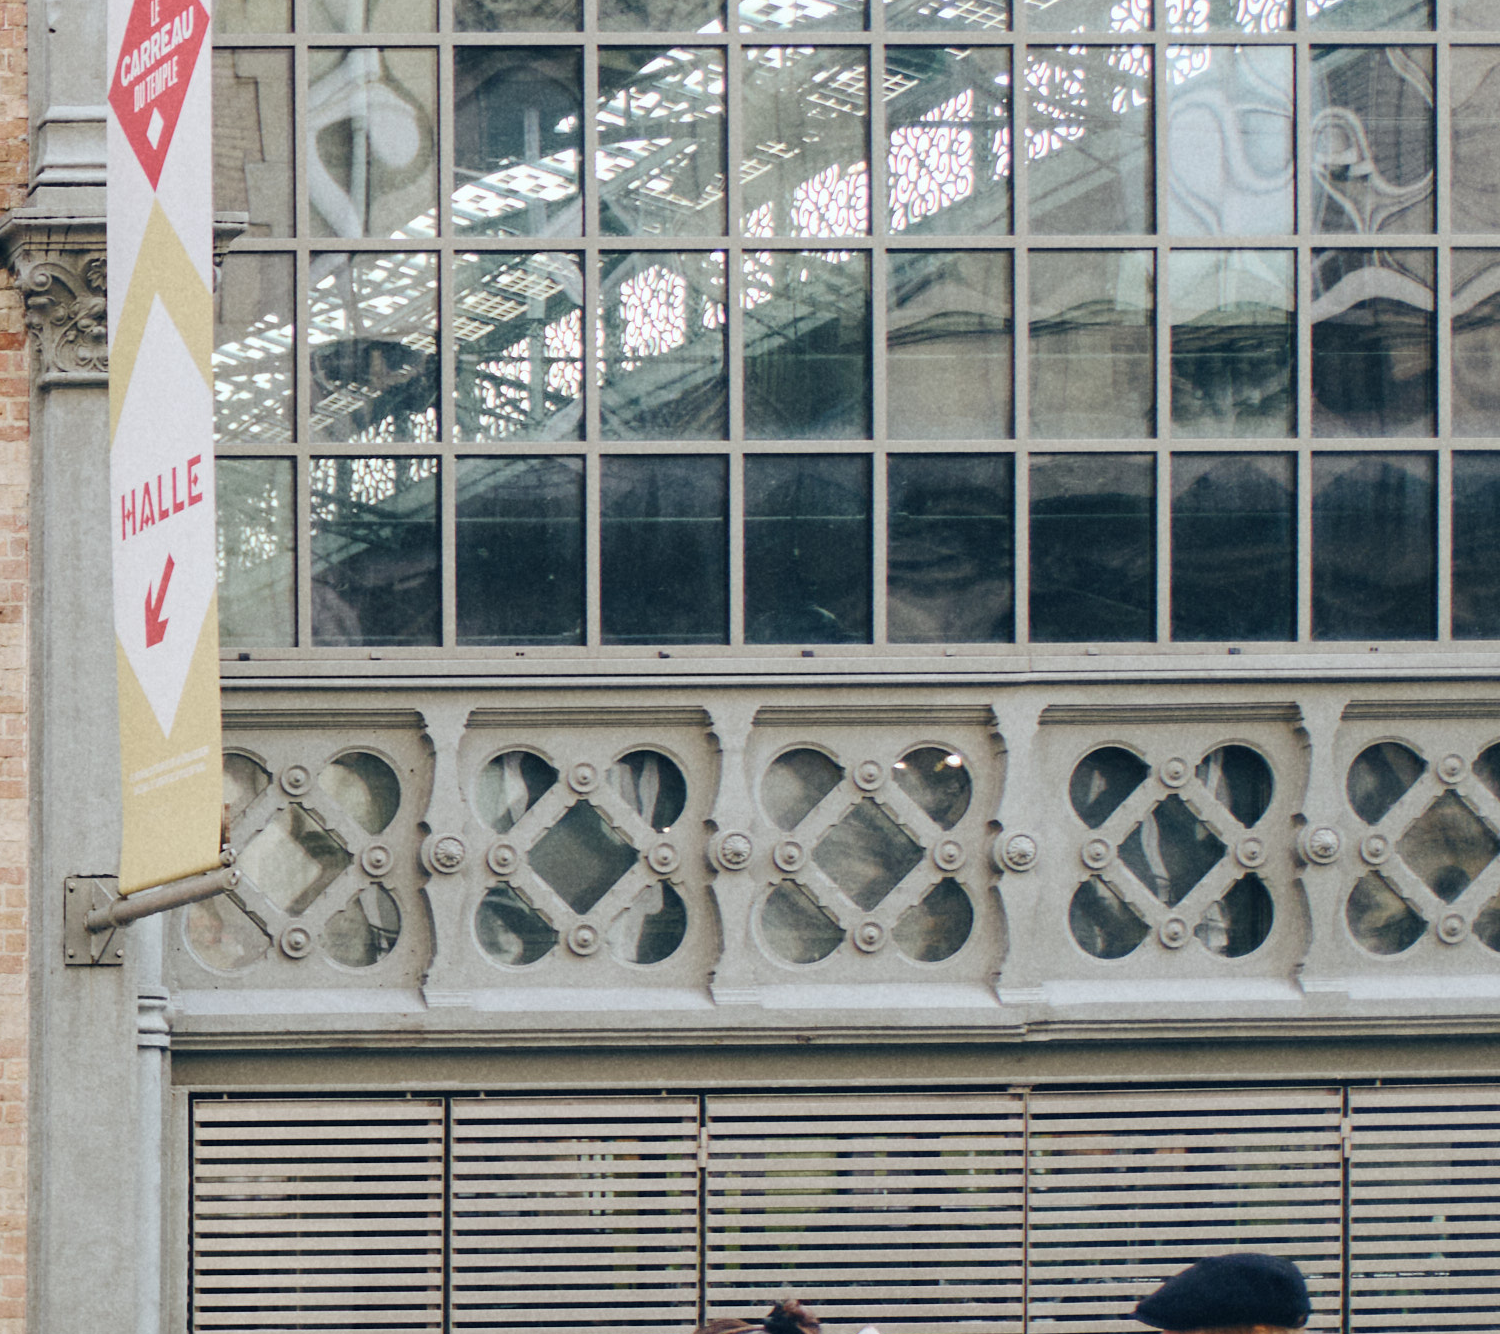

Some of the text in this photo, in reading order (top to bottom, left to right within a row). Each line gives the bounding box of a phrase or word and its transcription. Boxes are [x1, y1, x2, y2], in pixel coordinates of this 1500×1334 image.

[121, 5, 194, 87] CARREAU
[134, 55, 178, 113] DU TEMPLE
[121, 454, 203, 541] HALLE
